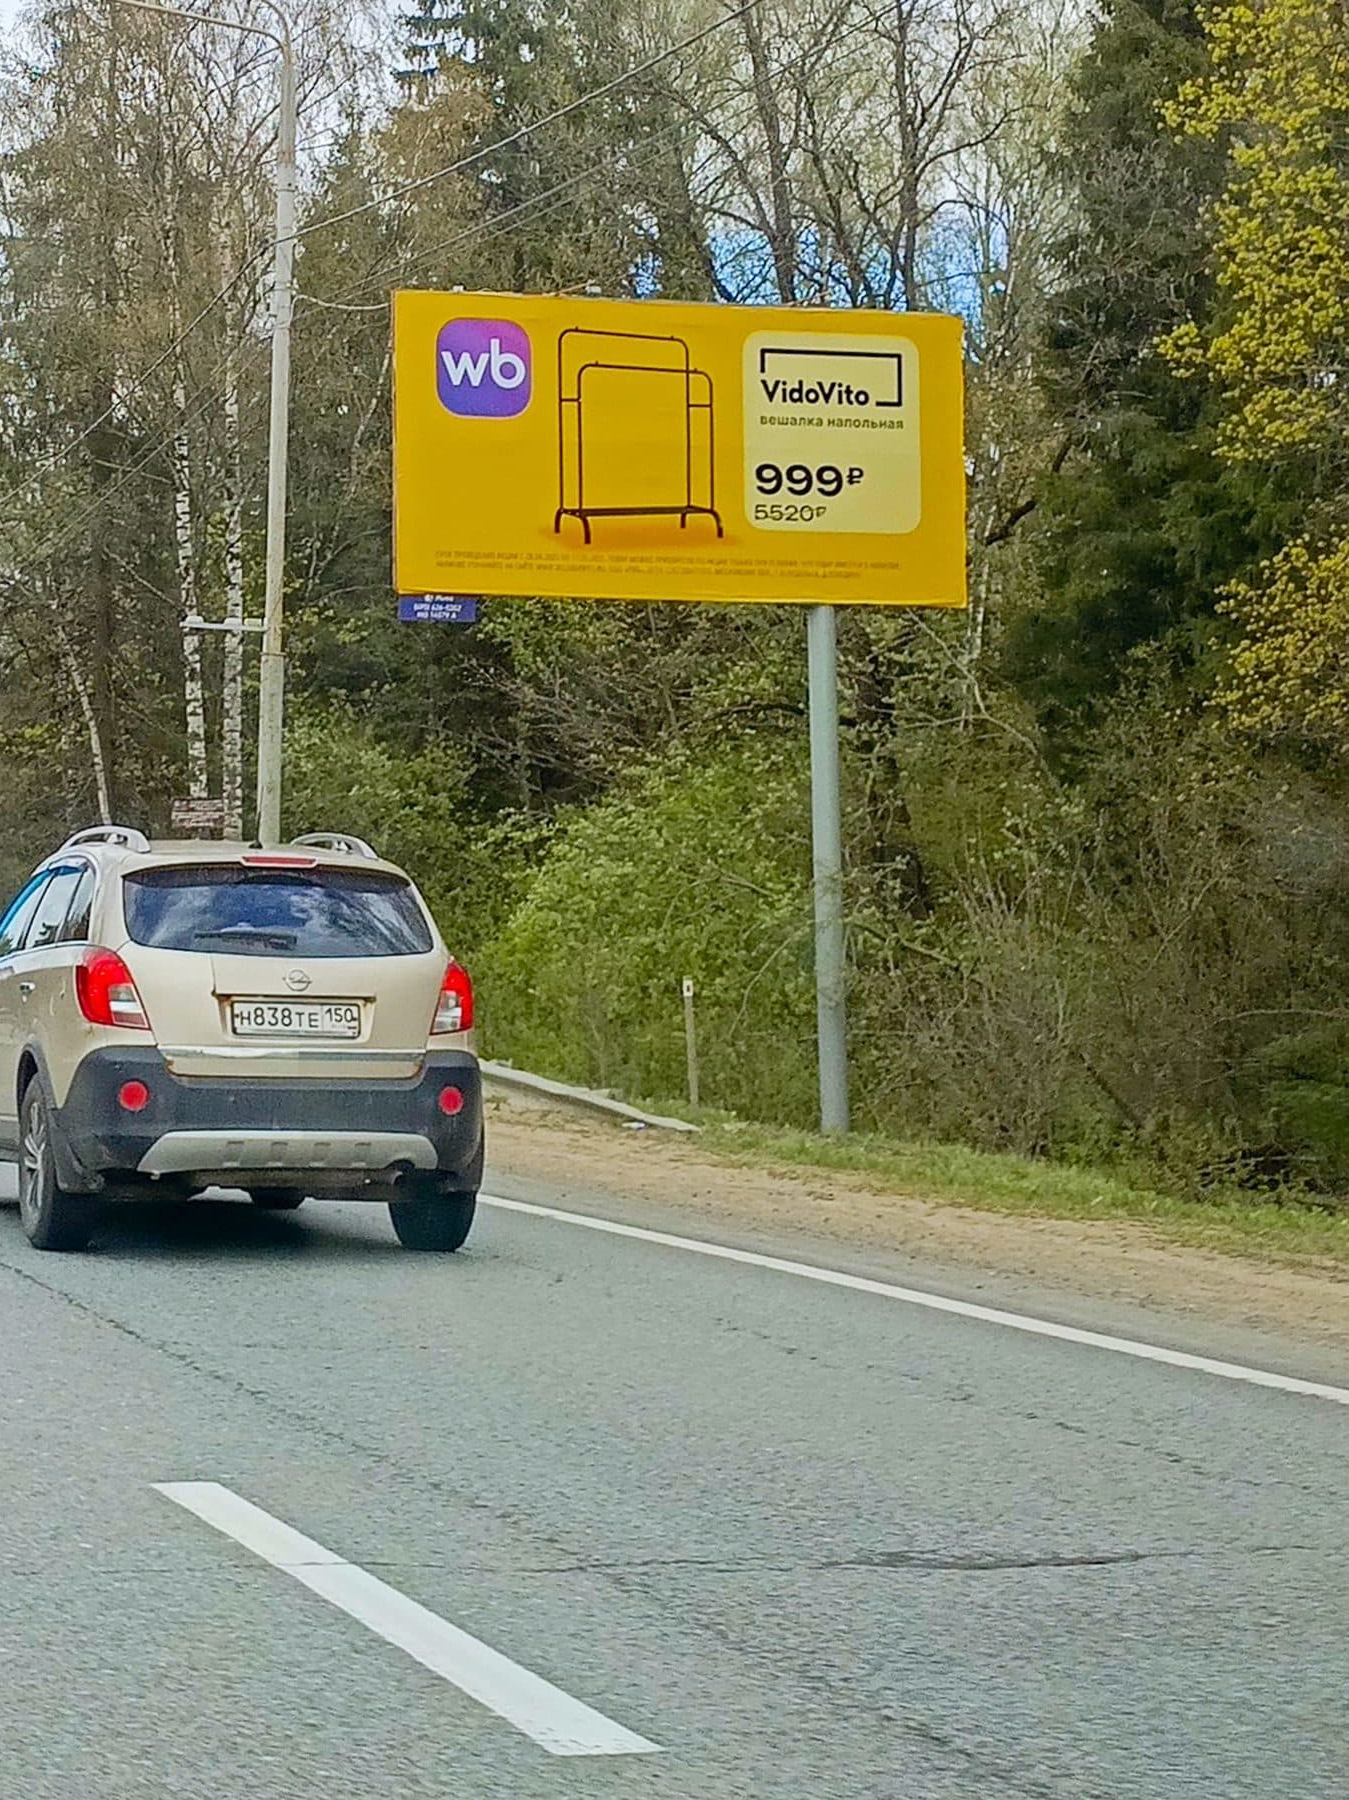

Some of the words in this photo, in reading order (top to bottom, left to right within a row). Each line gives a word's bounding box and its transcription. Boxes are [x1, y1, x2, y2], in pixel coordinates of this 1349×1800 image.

[441, 338, 526, 389] wb
[761, 379, 869, 406] VidoVito
[760, 415, 823, 427] вешалка
[827, 417, 904, 430] напольная
[325, 1007, 354, 1023] 150
